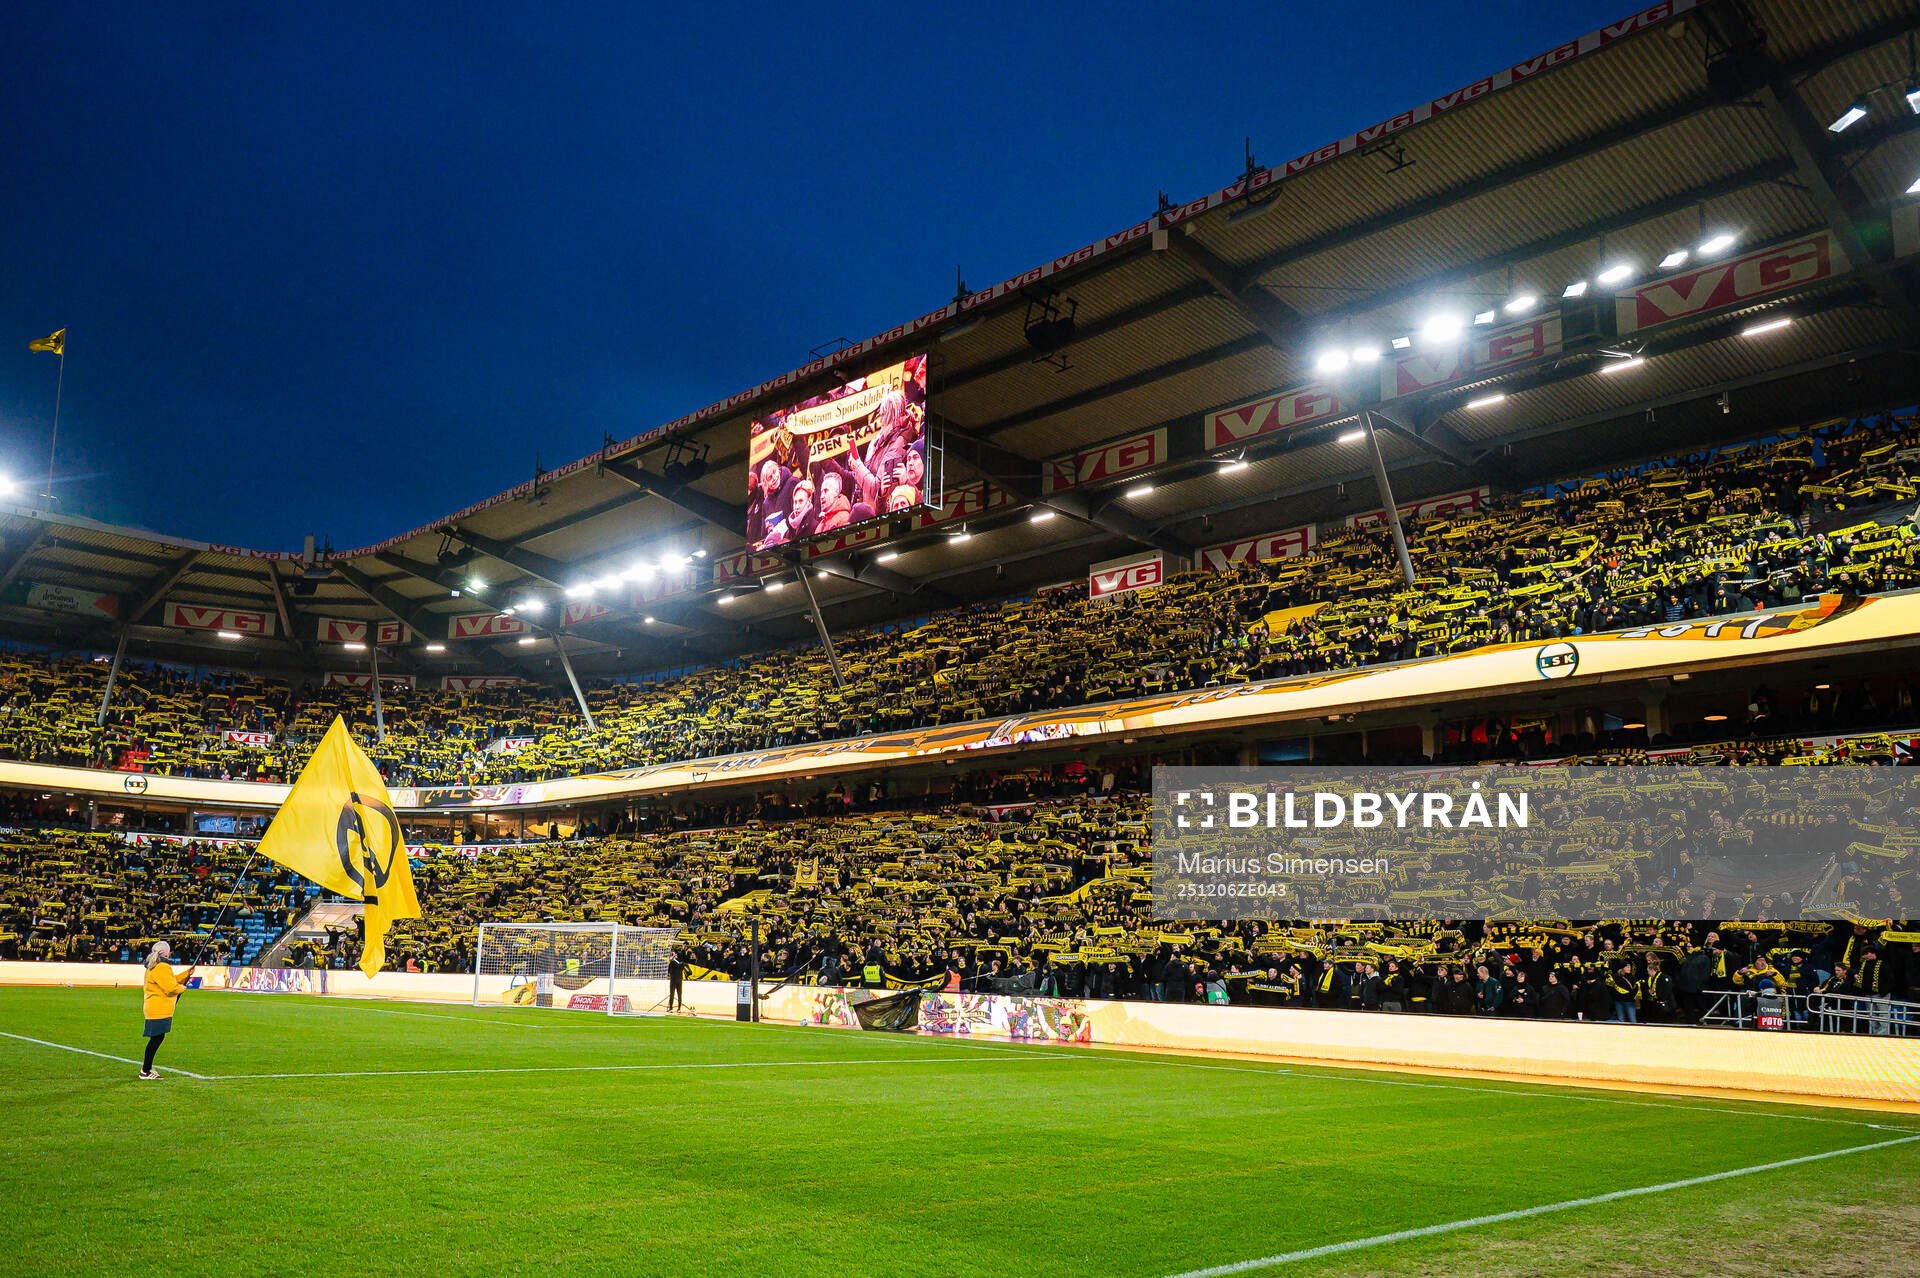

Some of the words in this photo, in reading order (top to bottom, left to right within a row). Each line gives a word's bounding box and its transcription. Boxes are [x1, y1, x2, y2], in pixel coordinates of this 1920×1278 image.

[1603, 4, 1668, 38] VG
[1517, 44, 1575, 75] VG
[1433, 80, 1489, 110] VG
[1357, 112, 1412, 141] VG
[1288, 144, 1338, 171] VG
[1224, 172, 1272, 197] VG
[1164, 199, 1208, 222] VG
[1108, 224, 1147, 247] VG
[1055, 247, 1093, 269] VG
[1005, 268, 1042, 288] VG
[1640, 241, 1820, 317] VG
[960, 289, 993, 309] VG
[914, 308, 947, 327] VG
[873, 327, 903, 345] VG
[834, 344, 863, 363] VG
[1400, 322, 1535, 386] VG
[797, 361, 824, 377] VG
[762, 376, 787, 391] VG
[728, 391, 752, 406] VG
[697, 403, 719, 419] VG
[1219, 378, 1335, 438] VG
[666, 417, 688, 431] VG
[639, 429, 659, 441] VG
[612, 440, 631, 453] VG
[583, 452, 602, 465] VG
[1054, 438, 1151, 484] VG
[559, 463, 577, 475] VG
[538, 472, 553, 484] VG
[512, 483, 530, 495] VG
[491, 492, 507, 504] VG
[449, 510, 465, 521] VG
[470, 502, 486, 513] VG
[410, 526, 425, 536] VG
[429, 518, 446, 528] VG
[375, 541, 389, 550] VG
[392, 535, 407, 543] VG
[211, 544, 240, 554] VG
[251, 550, 279, 559] VG
[328, 552, 346, 560] VG
[352, 547, 372, 555] VG
[1094, 564, 1156, 590] VG
[177, 606, 262, 634] VG
[457, 614, 520, 635] VG
[1619, 614, 1775, 639] 2017
[1541, 654, 1574, 668] LSK
[232, 733, 266, 742] VG
